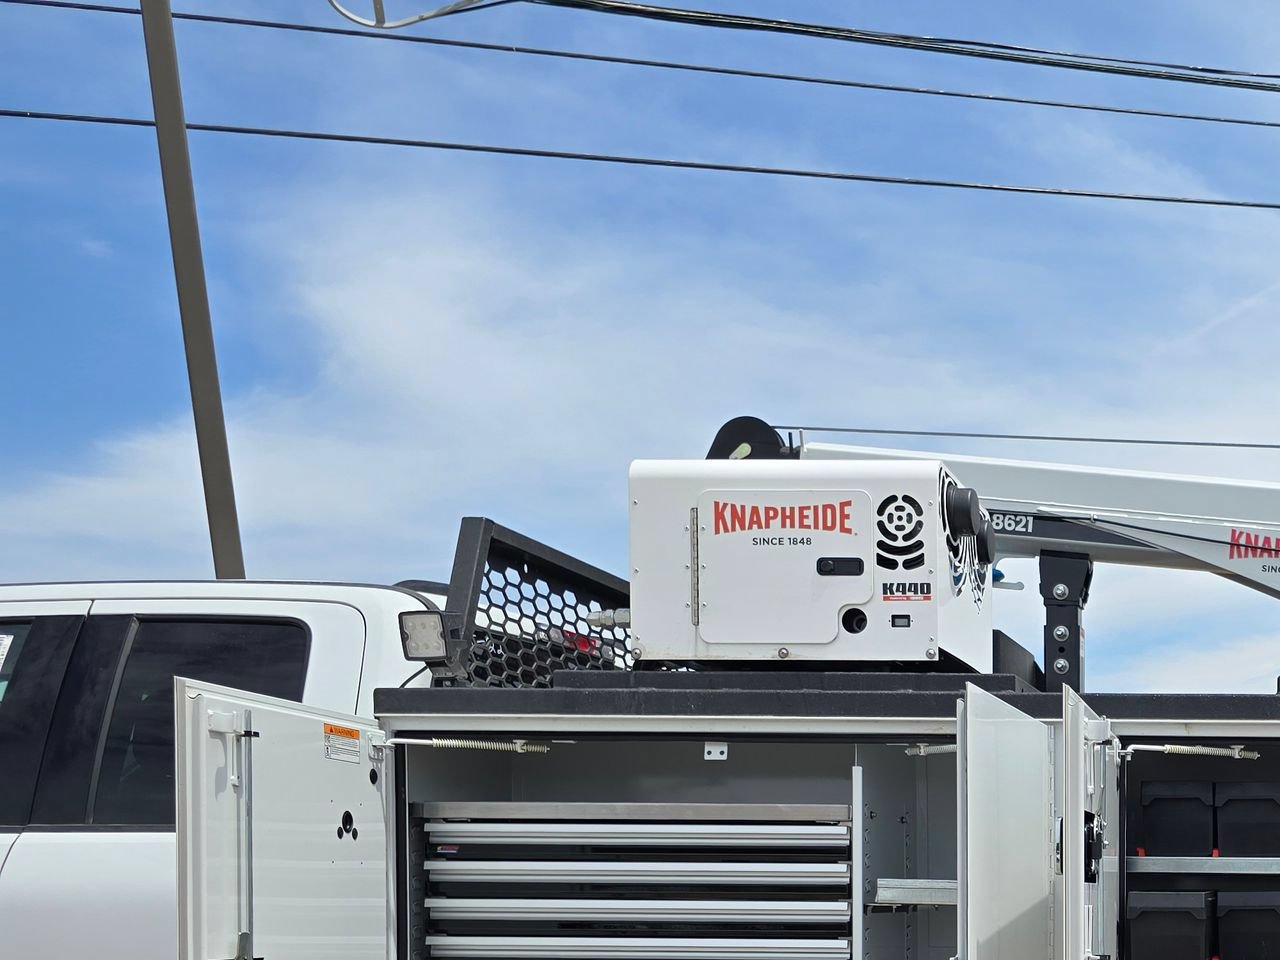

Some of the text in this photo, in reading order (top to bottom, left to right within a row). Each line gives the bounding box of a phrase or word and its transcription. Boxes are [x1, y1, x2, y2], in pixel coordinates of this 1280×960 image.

[713, 500, 853, 536] KNAPHEIDE
[991, 513, 1034, 533] 8621
[752, 537, 812, 546] SINCE 1848
[882, 582, 932, 595] K440
